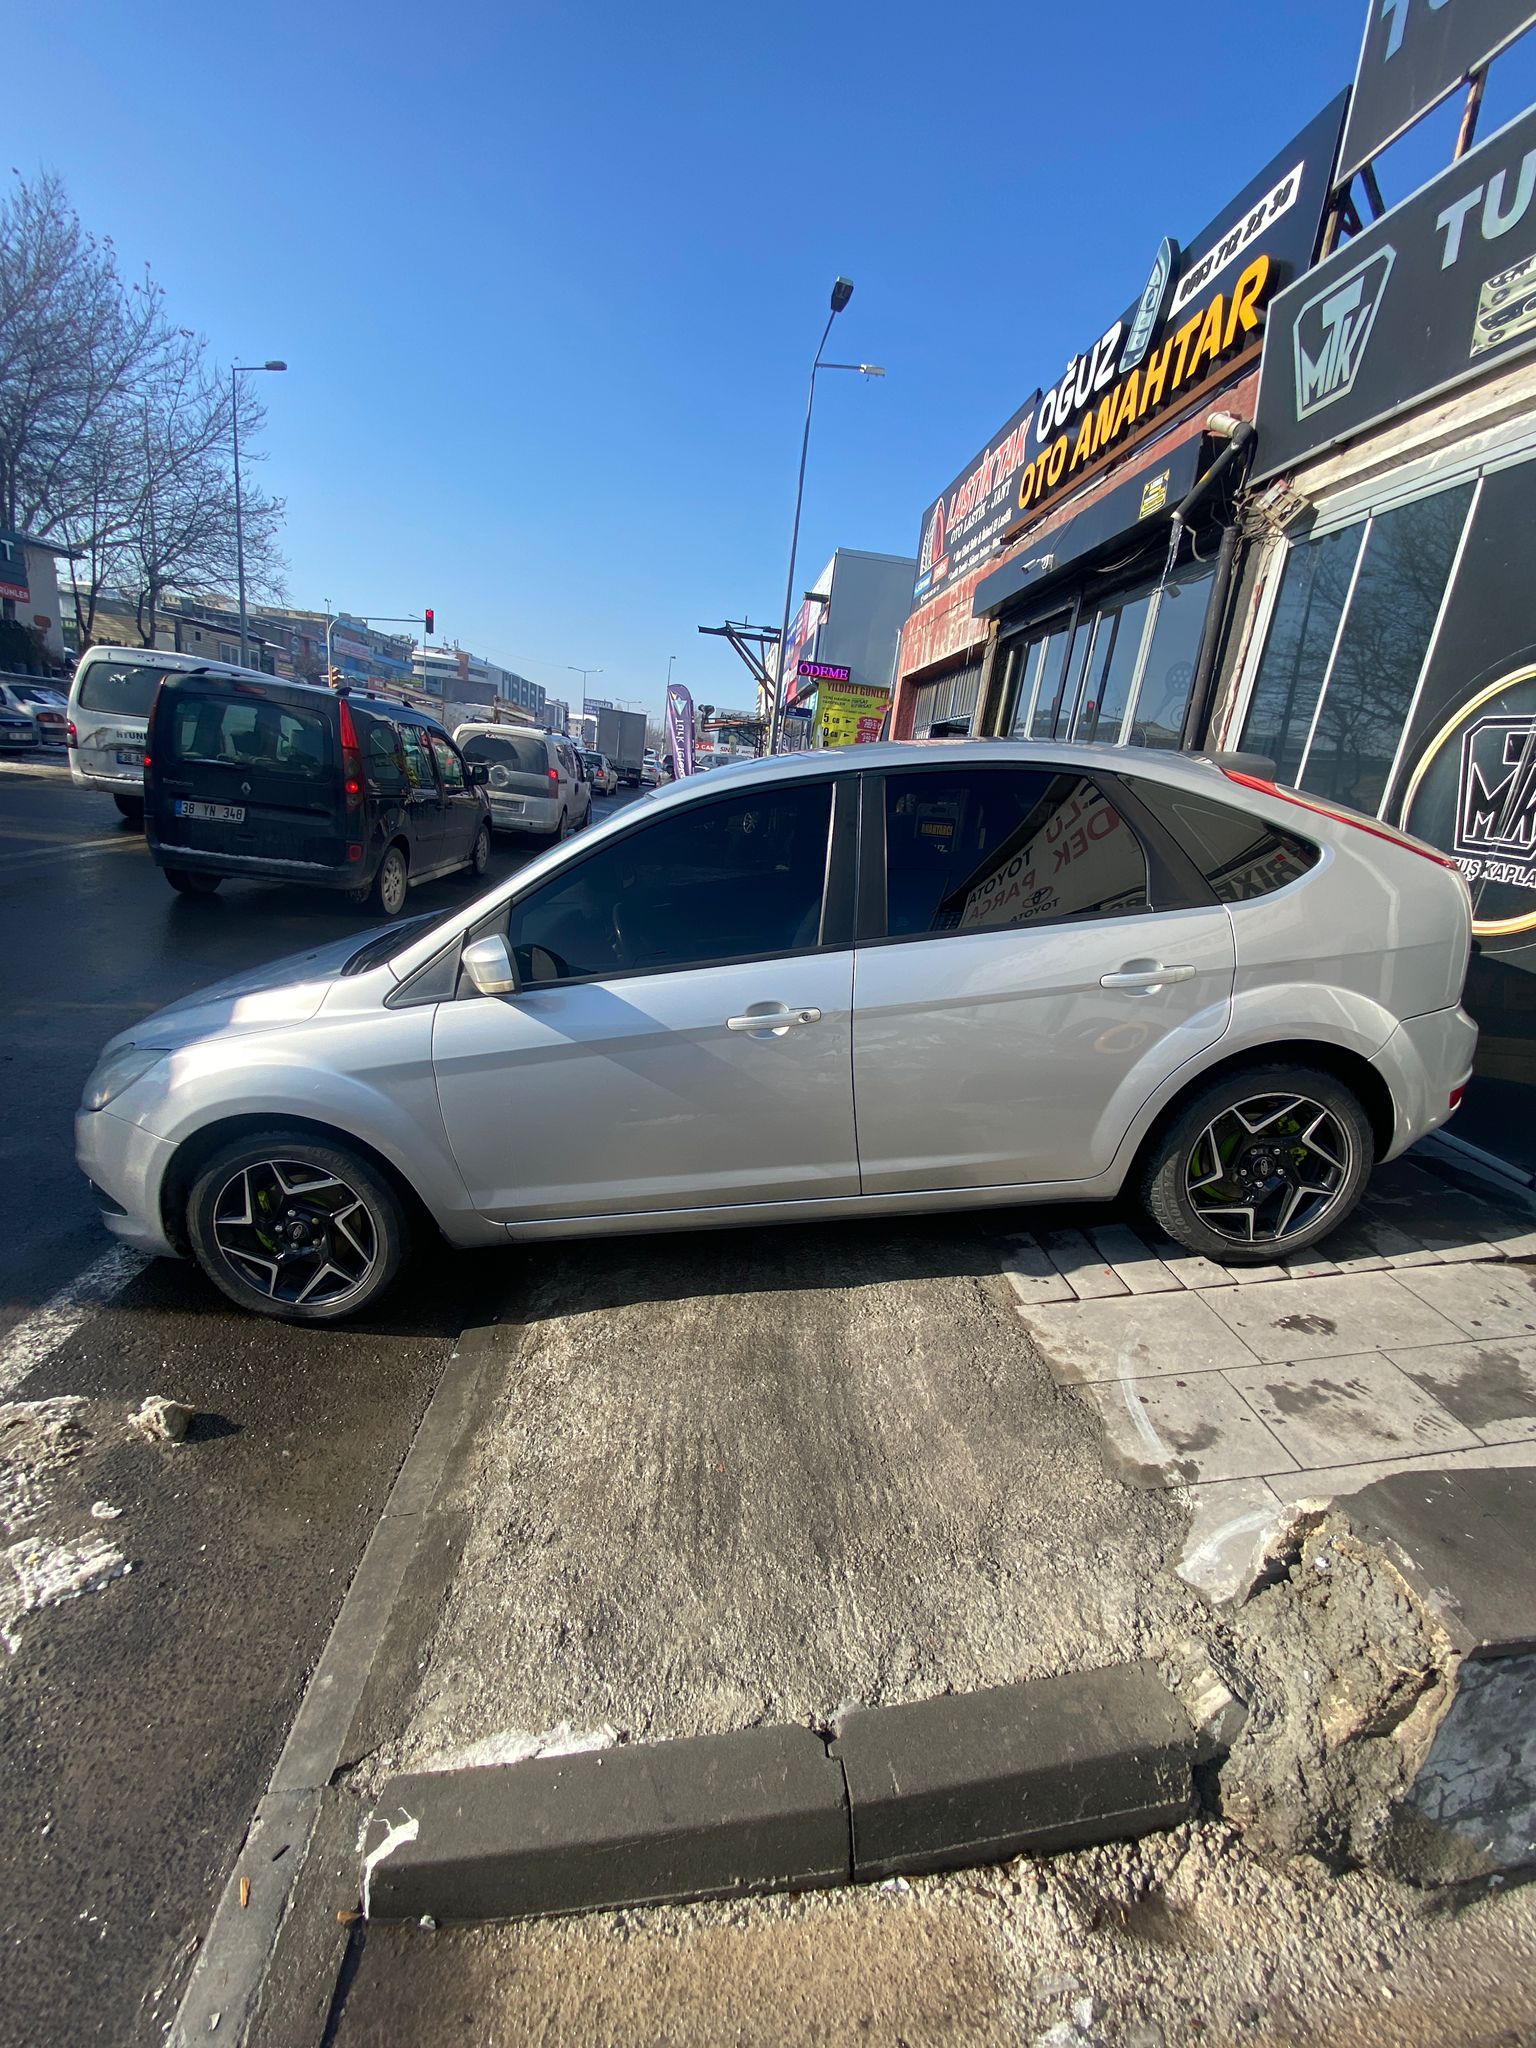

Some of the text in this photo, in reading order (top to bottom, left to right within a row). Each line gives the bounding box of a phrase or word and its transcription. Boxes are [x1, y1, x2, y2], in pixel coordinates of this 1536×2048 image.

[1243, 203, 1268, 243] 22
[1018, 254, 1270, 510] OTO ANAHTAR
[1036, 321, 1122, 443] OĞUZ
[799, 661, 849, 680] ÖDEME
[116, 731, 147, 741] HYUN
[182, 802, 243, 820] 38 YN 348
